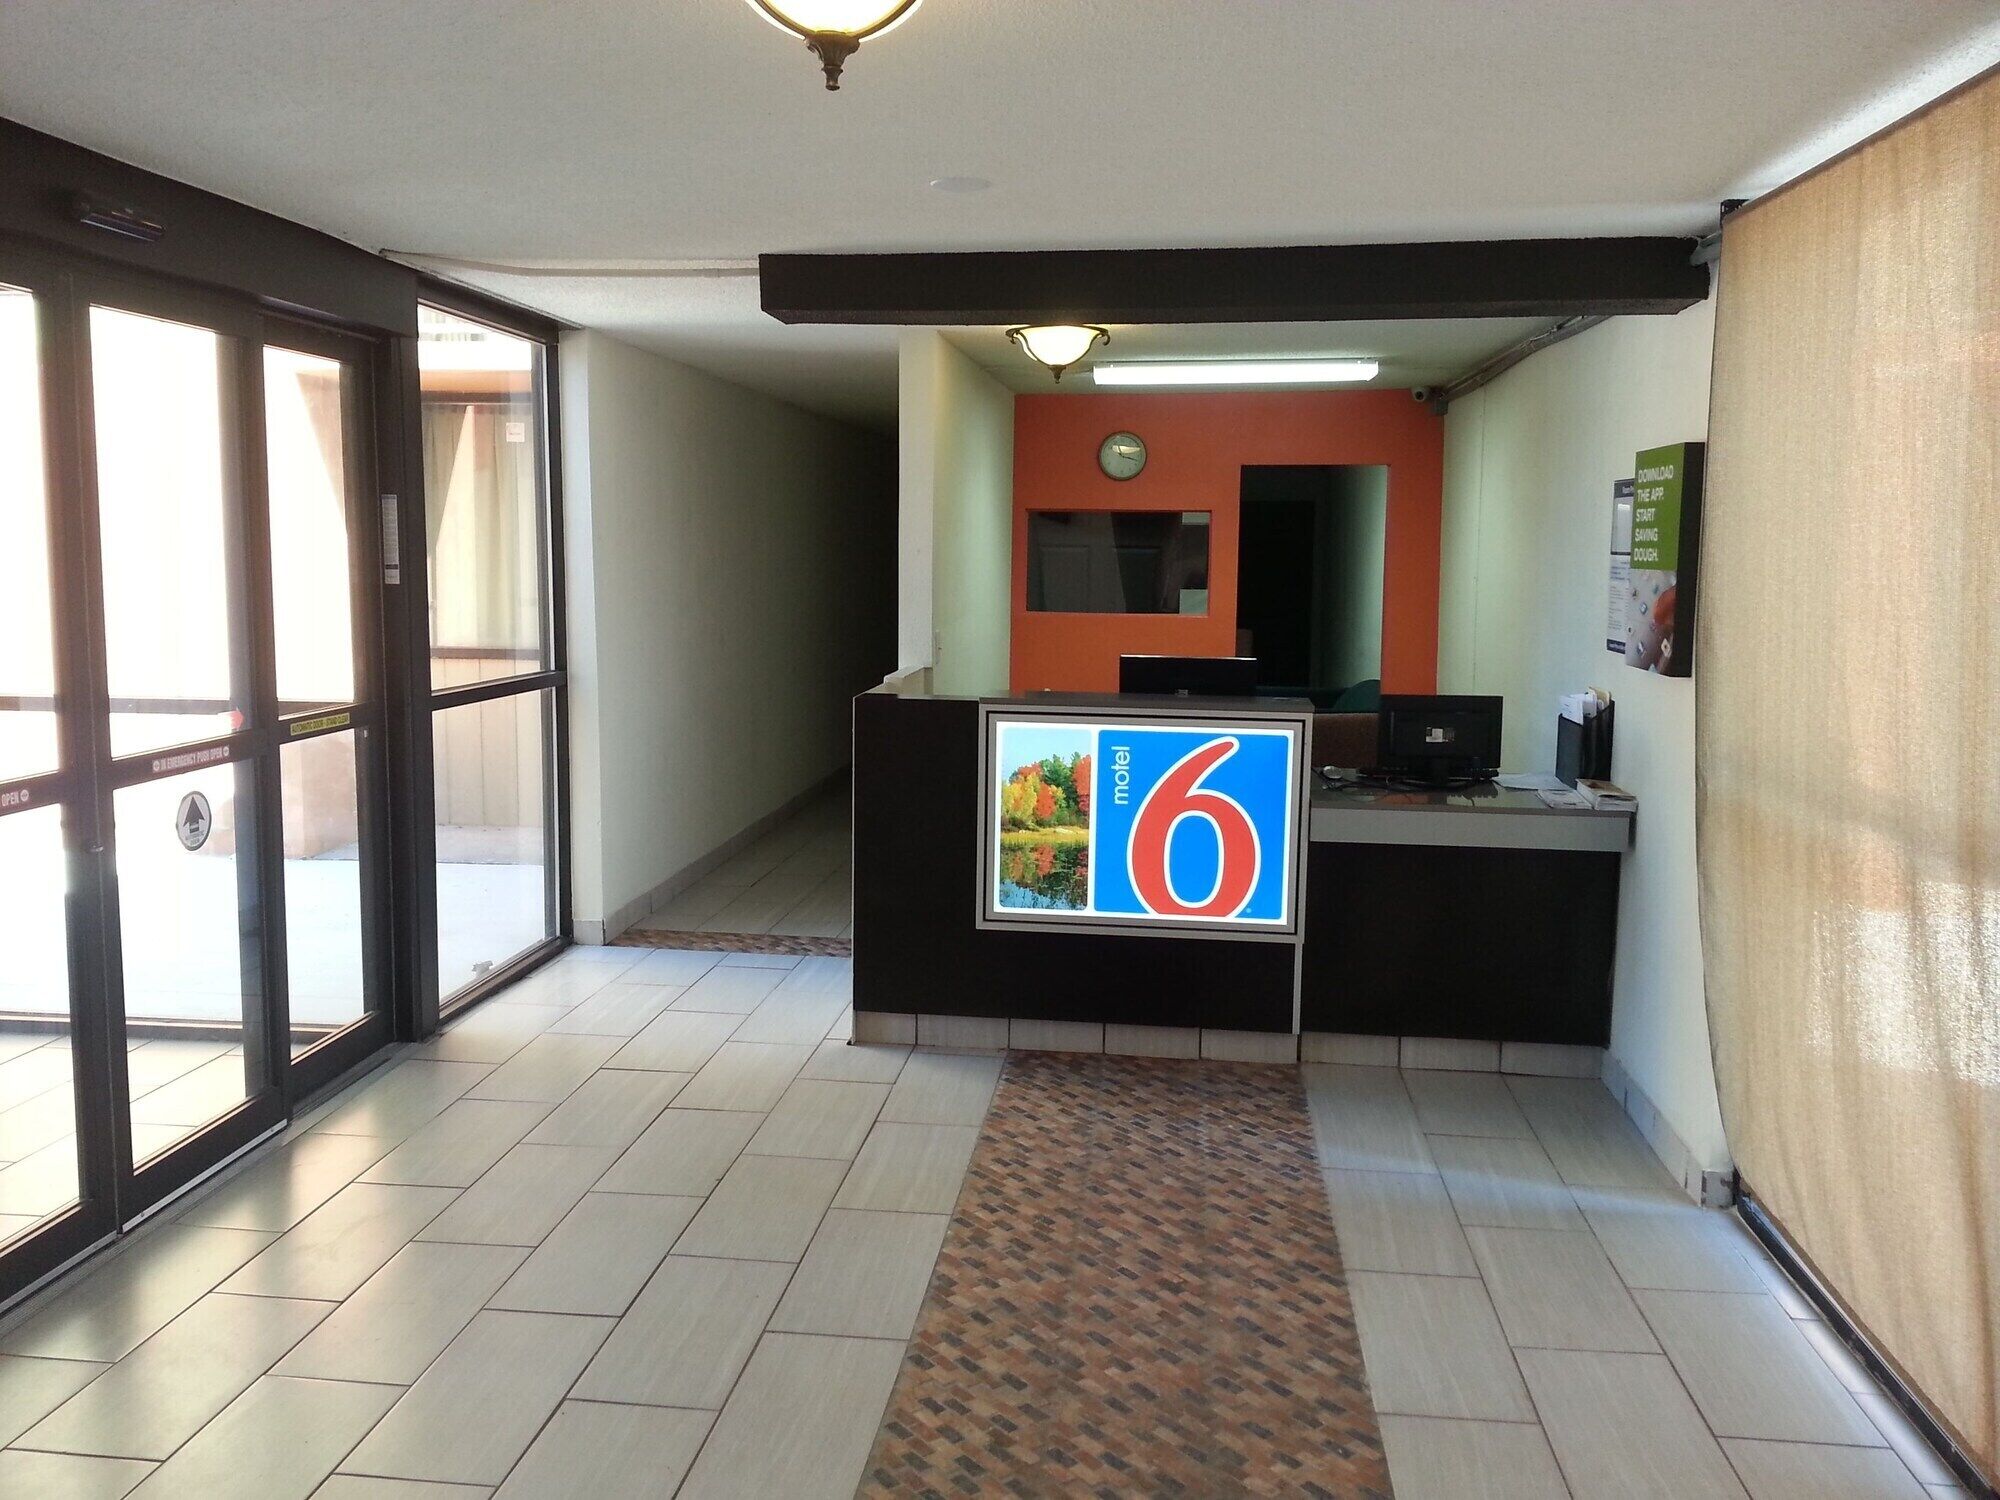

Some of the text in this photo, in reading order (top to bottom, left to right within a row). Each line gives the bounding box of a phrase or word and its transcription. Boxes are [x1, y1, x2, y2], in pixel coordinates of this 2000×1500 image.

[1638, 464, 1674, 483] DOWNLOAD
[1637, 488, 1650, 502] THE
[1636, 508, 1656, 522] START
[1635, 528, 1658, 542] SAVING
[167, 752, 196, 769] EMERGENCY
[197, 749, 210, 763] PUSH
[210, 746, 223, 760] OPEN
[1111, 745, 1131, 805] motel
[1, 787, 19, 807] OPEN
[1126, 735, 1262, 918] 6
